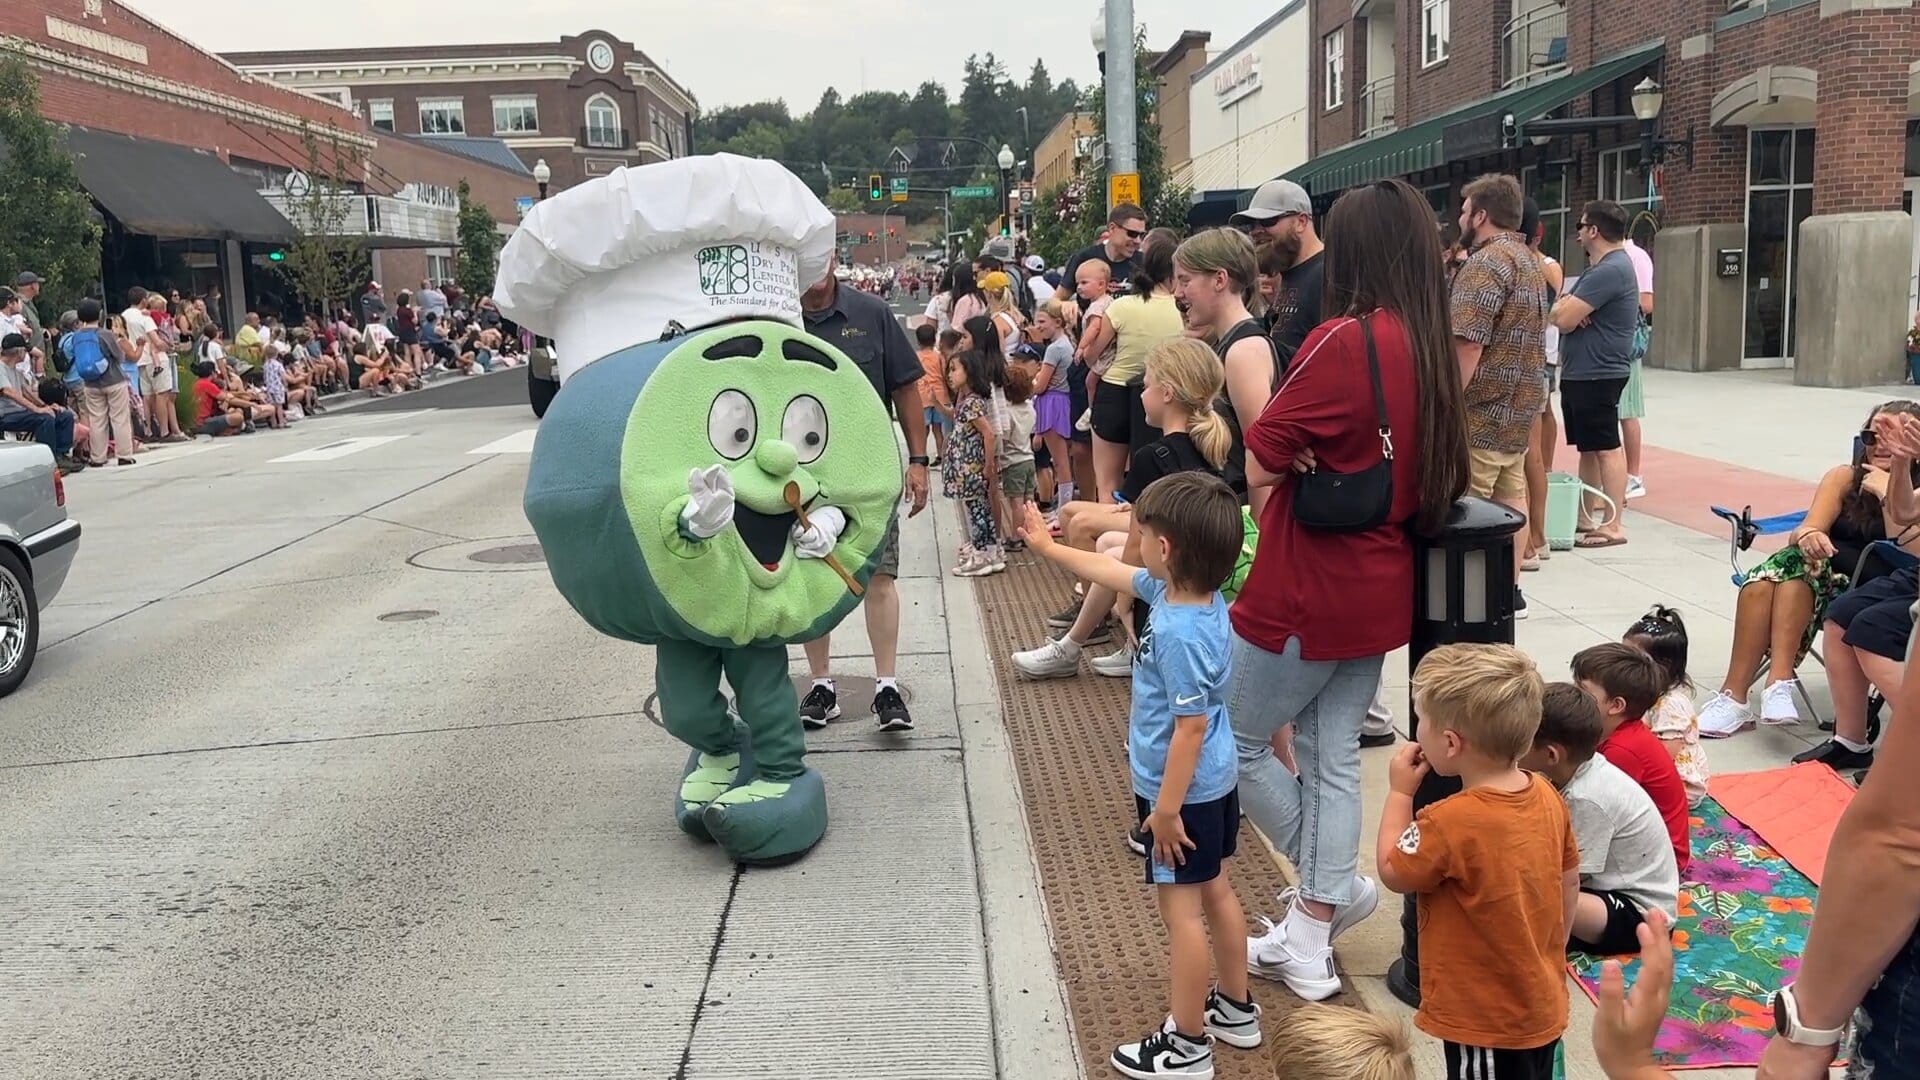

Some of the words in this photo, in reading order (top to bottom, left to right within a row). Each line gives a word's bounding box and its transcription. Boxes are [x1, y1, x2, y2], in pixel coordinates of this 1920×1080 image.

[775, 246, 781, 257] S
[781, 260, 797, 275] PEA
[753, 281, 798, 299] CHICKPEA
[709, 297, 728, 306] The
[729, 296, 767, 307] Standard
[769, 298, 779, 310] for
